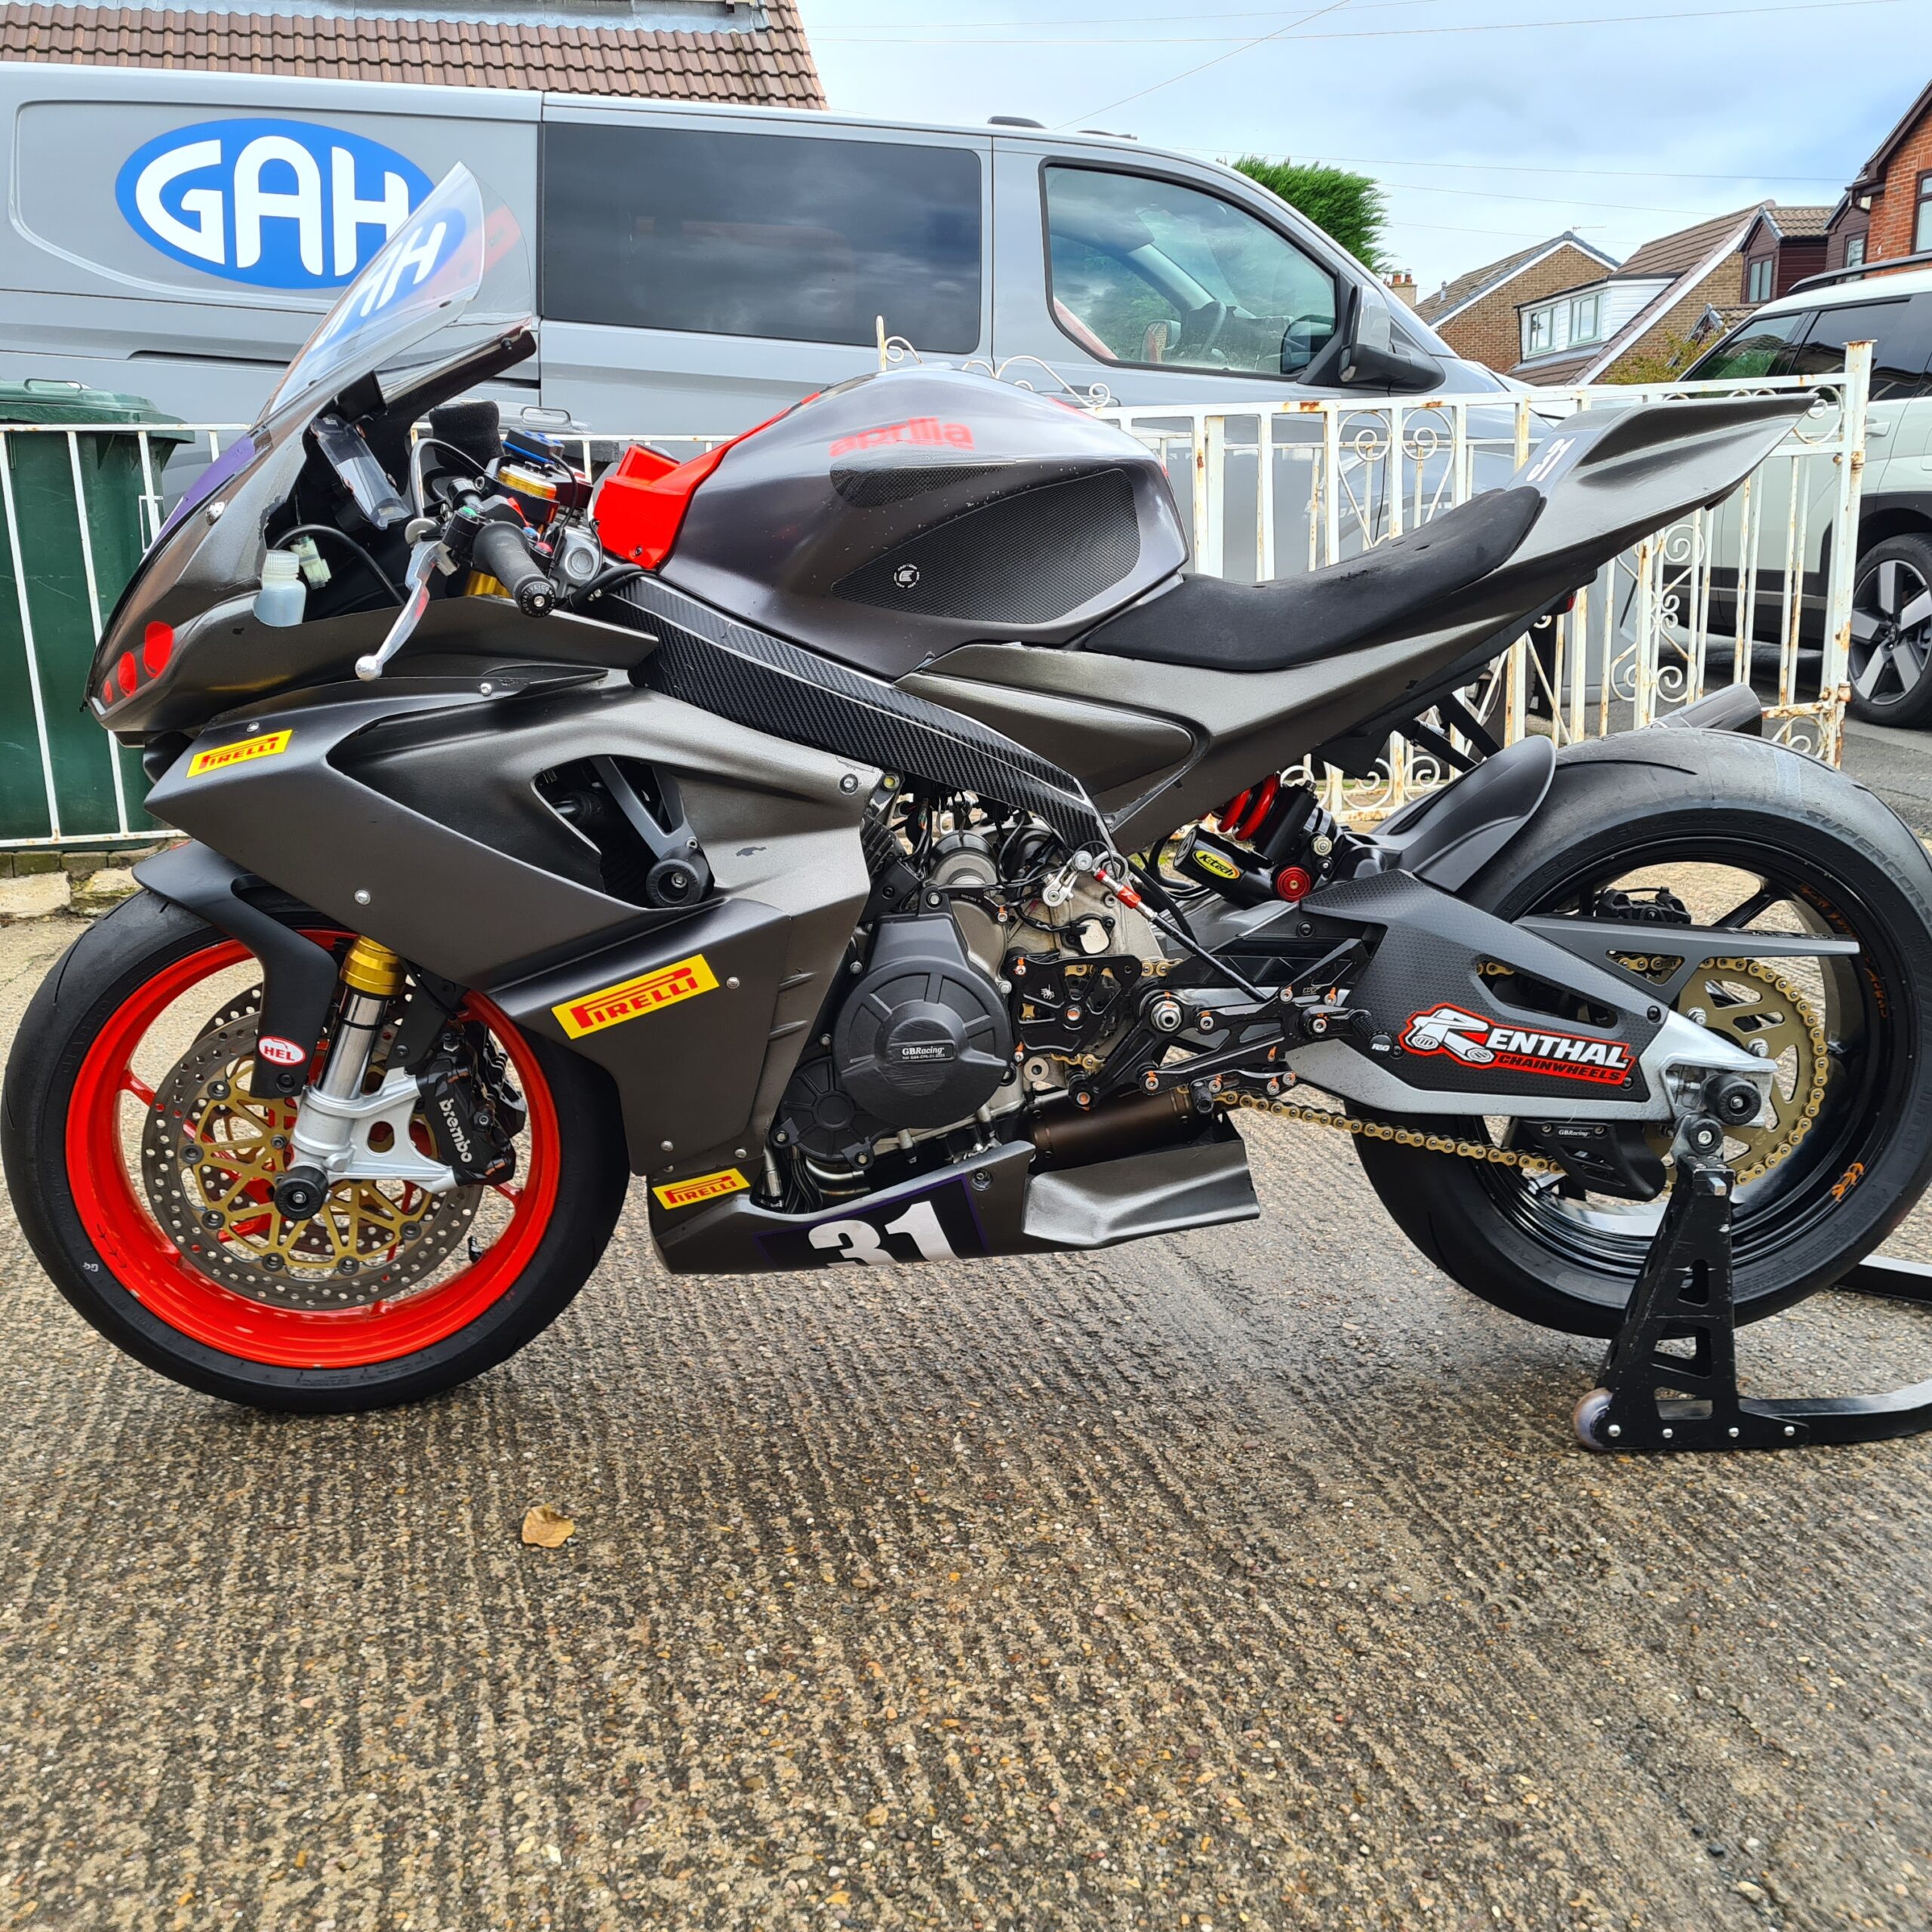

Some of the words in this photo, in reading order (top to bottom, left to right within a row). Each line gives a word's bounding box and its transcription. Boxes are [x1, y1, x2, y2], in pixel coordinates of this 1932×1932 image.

[135, 135, 409, 276] GAH
[1525, 437, 1576, 482] 31
[198, 736, 280, 770] PIRELLI
[569, 967, 699, 1029] PIRELLI
[264, 1044, 295, 1062] HEL
[901, 1045, 945, 1056] GBRacing
[1404, 1008, 1629, 1069] RENTHAL
[1497, 1055, 1622, 1081] CHAINWHEELS
[438, 1097, 472, 1163] brembo
[663, 1175, 737, 1204] PIRELLI
[808, 1200, 961, 1269] 31
